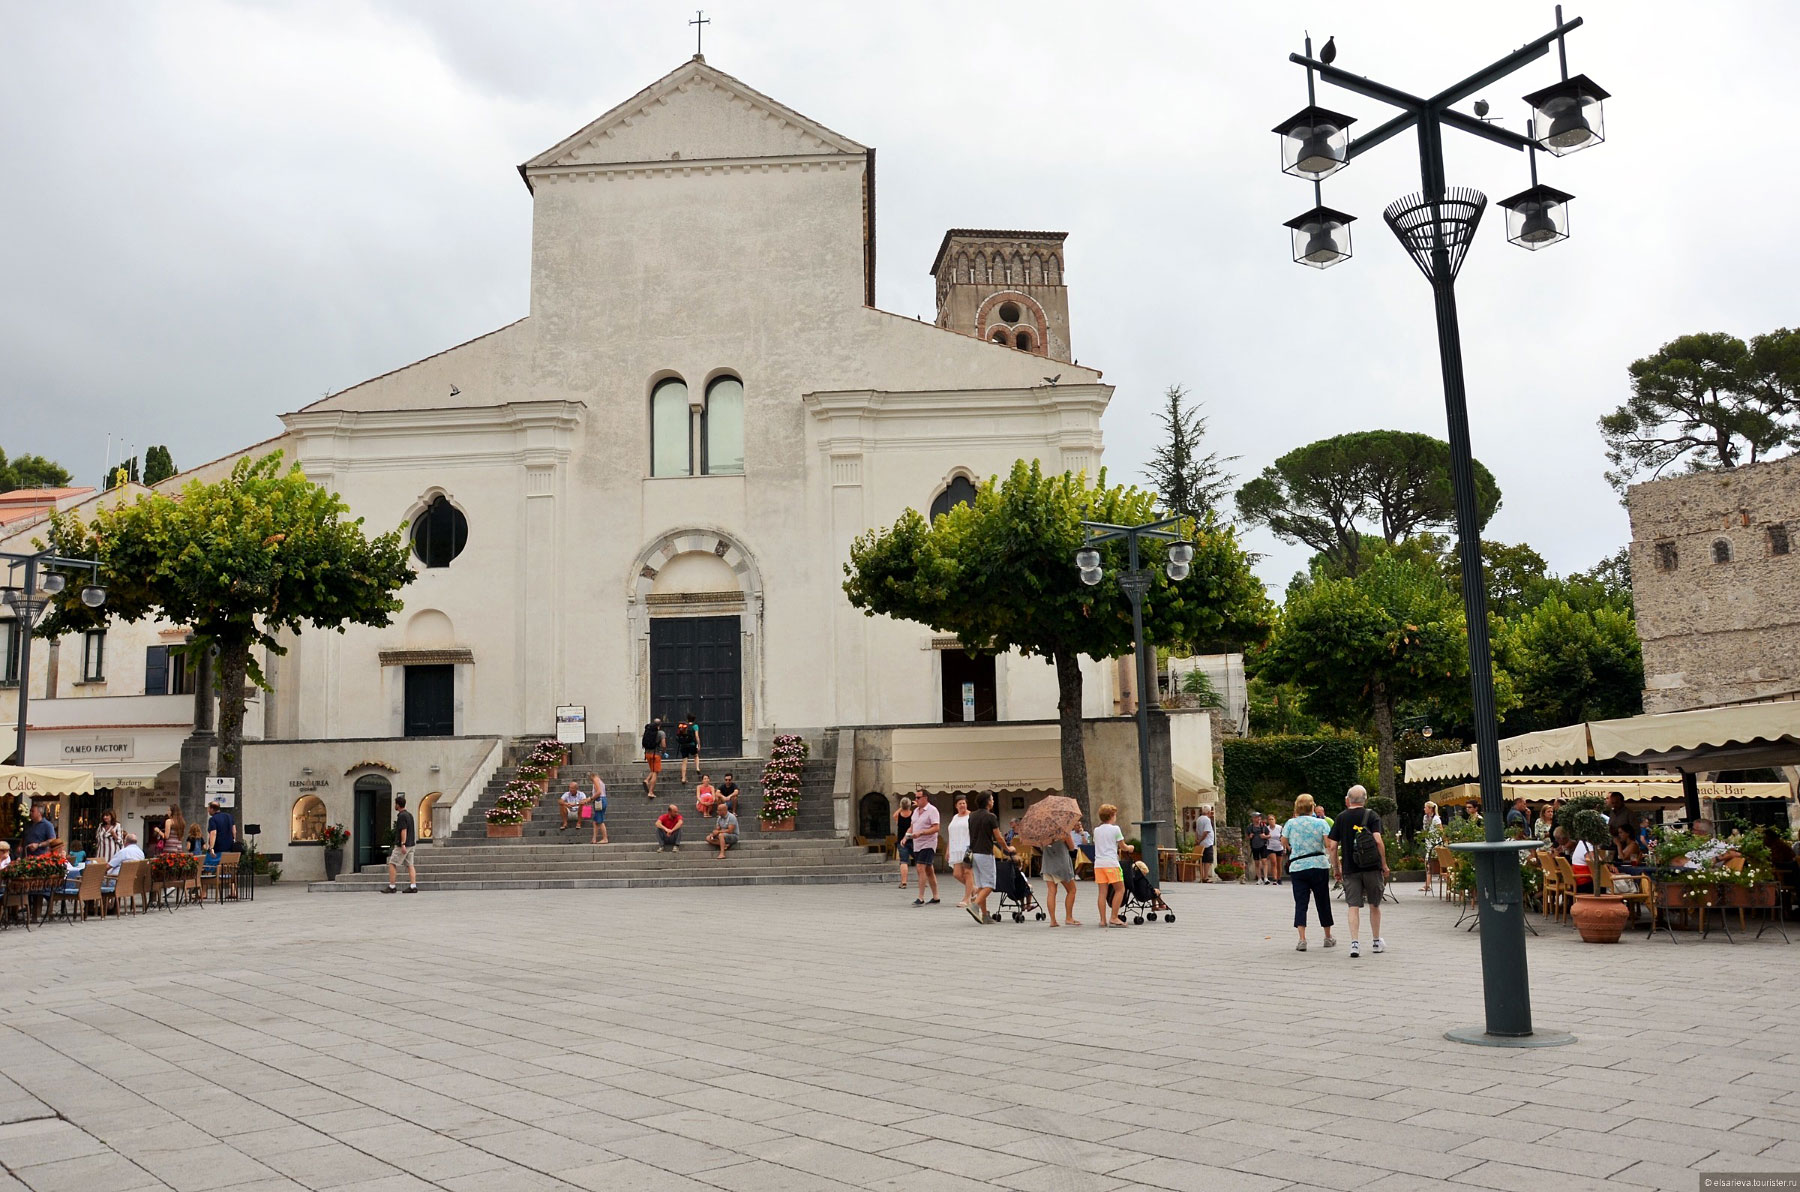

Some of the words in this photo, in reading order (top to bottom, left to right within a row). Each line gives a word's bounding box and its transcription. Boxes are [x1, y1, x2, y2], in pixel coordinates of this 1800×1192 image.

[64, 745, 92, 753] CAMEO
[94, 744, 128, 752] FACTORY
[8, 775, 37, 791] Calce
[116, 778, 142, 787] Factory
[989, 779, 1032, 789] Sandwiches
[1560, 787, 1606, 798] Klingsor
[1697, 784, 1746, 795] ack-Bar
